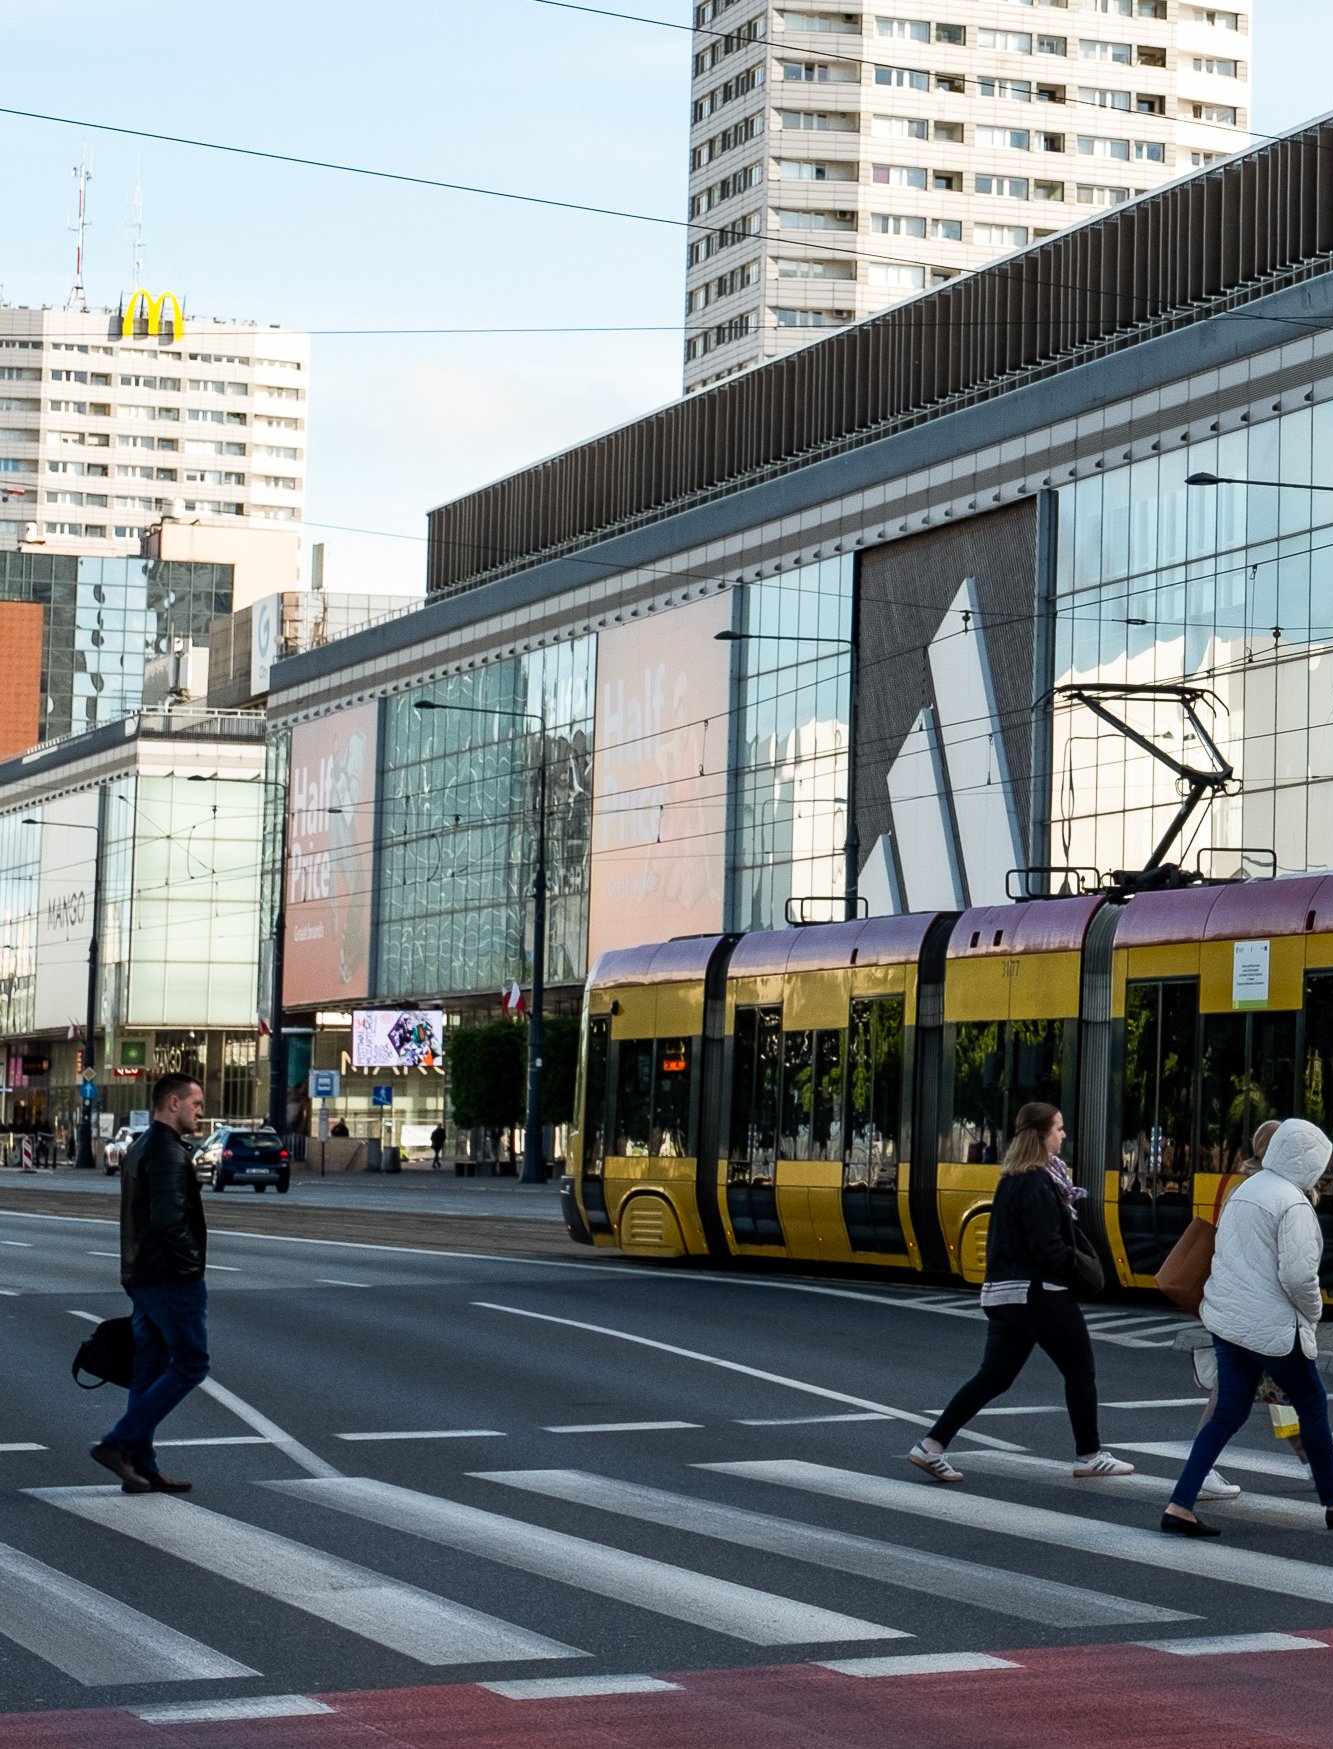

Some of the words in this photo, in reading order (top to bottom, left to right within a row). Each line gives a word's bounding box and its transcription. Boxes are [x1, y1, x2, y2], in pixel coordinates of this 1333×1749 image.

[603, 662, 667, 770] Half
[292, 754, 335, 838] Half
[290, 841, 331, 904] Price
